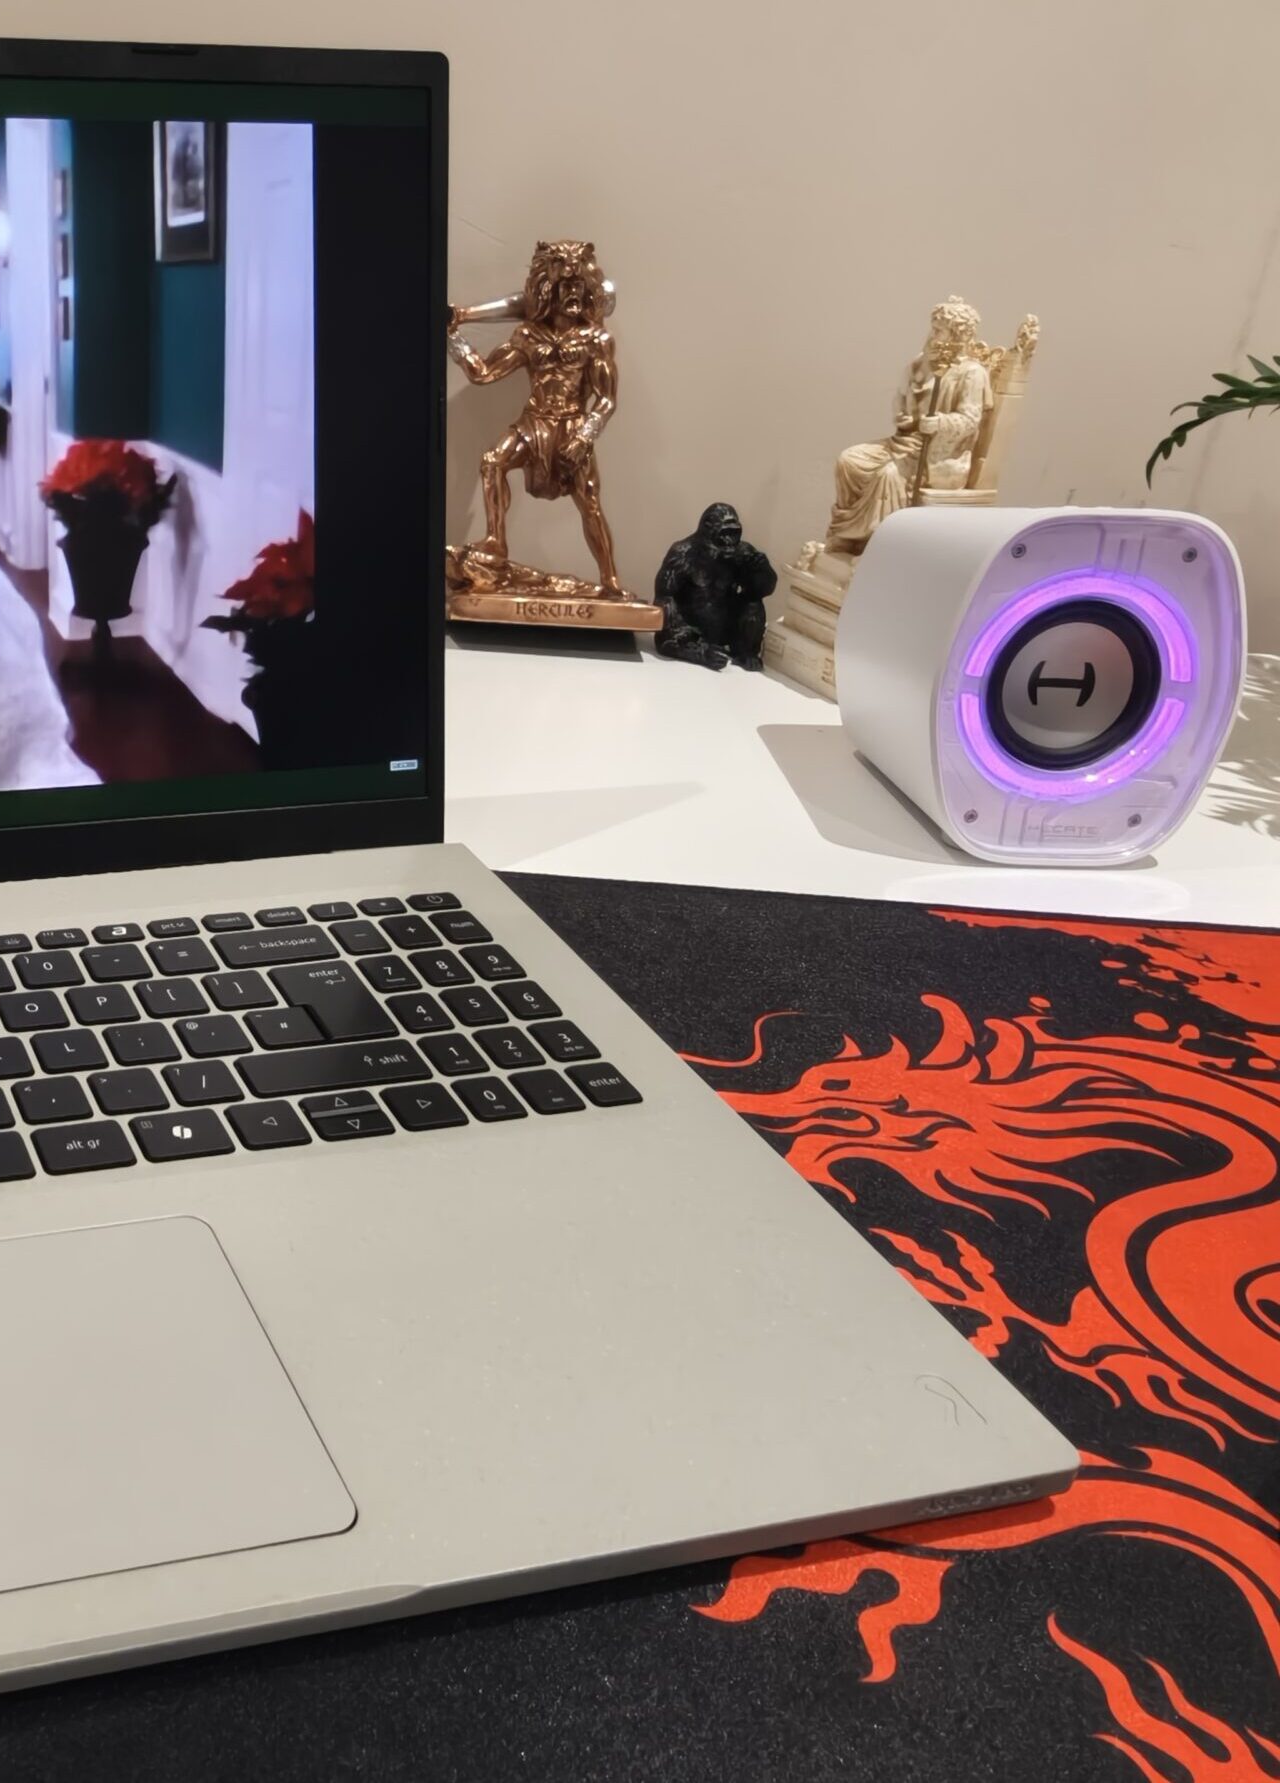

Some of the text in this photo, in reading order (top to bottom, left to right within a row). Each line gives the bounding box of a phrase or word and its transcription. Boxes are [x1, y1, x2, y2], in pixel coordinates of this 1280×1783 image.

[515, 601, 594, 619] HERCULES
[259, 936, 317, 949] backspace
[487, 955, 499, 964] 9
[42, 961, 54, 971] 0
[435, 960, 449, 970] 8
[308, 968, 339, 978] enter
[383, 966, 392, 976] 7
[96, 996, 108, 1006] P
[523, 992, 535, 1002] 6
[24, 1002, 39, 1013] O
[468, 998, 481, 1008] 5
[416, 1005, 427, 1015] 4
[558, 1033, 571, 1044] 3
[63, 1042, 76, 1053] L
[503, 1040, 517, 1050] 2
[448, 1046, 460, 1057] 1
[379, 1053, 408, 1065] shift
[588, 1076, 621, 1086] enter
[483, 1089, 497, 1101] 0
[66, 1138, 84, 1151] alt
